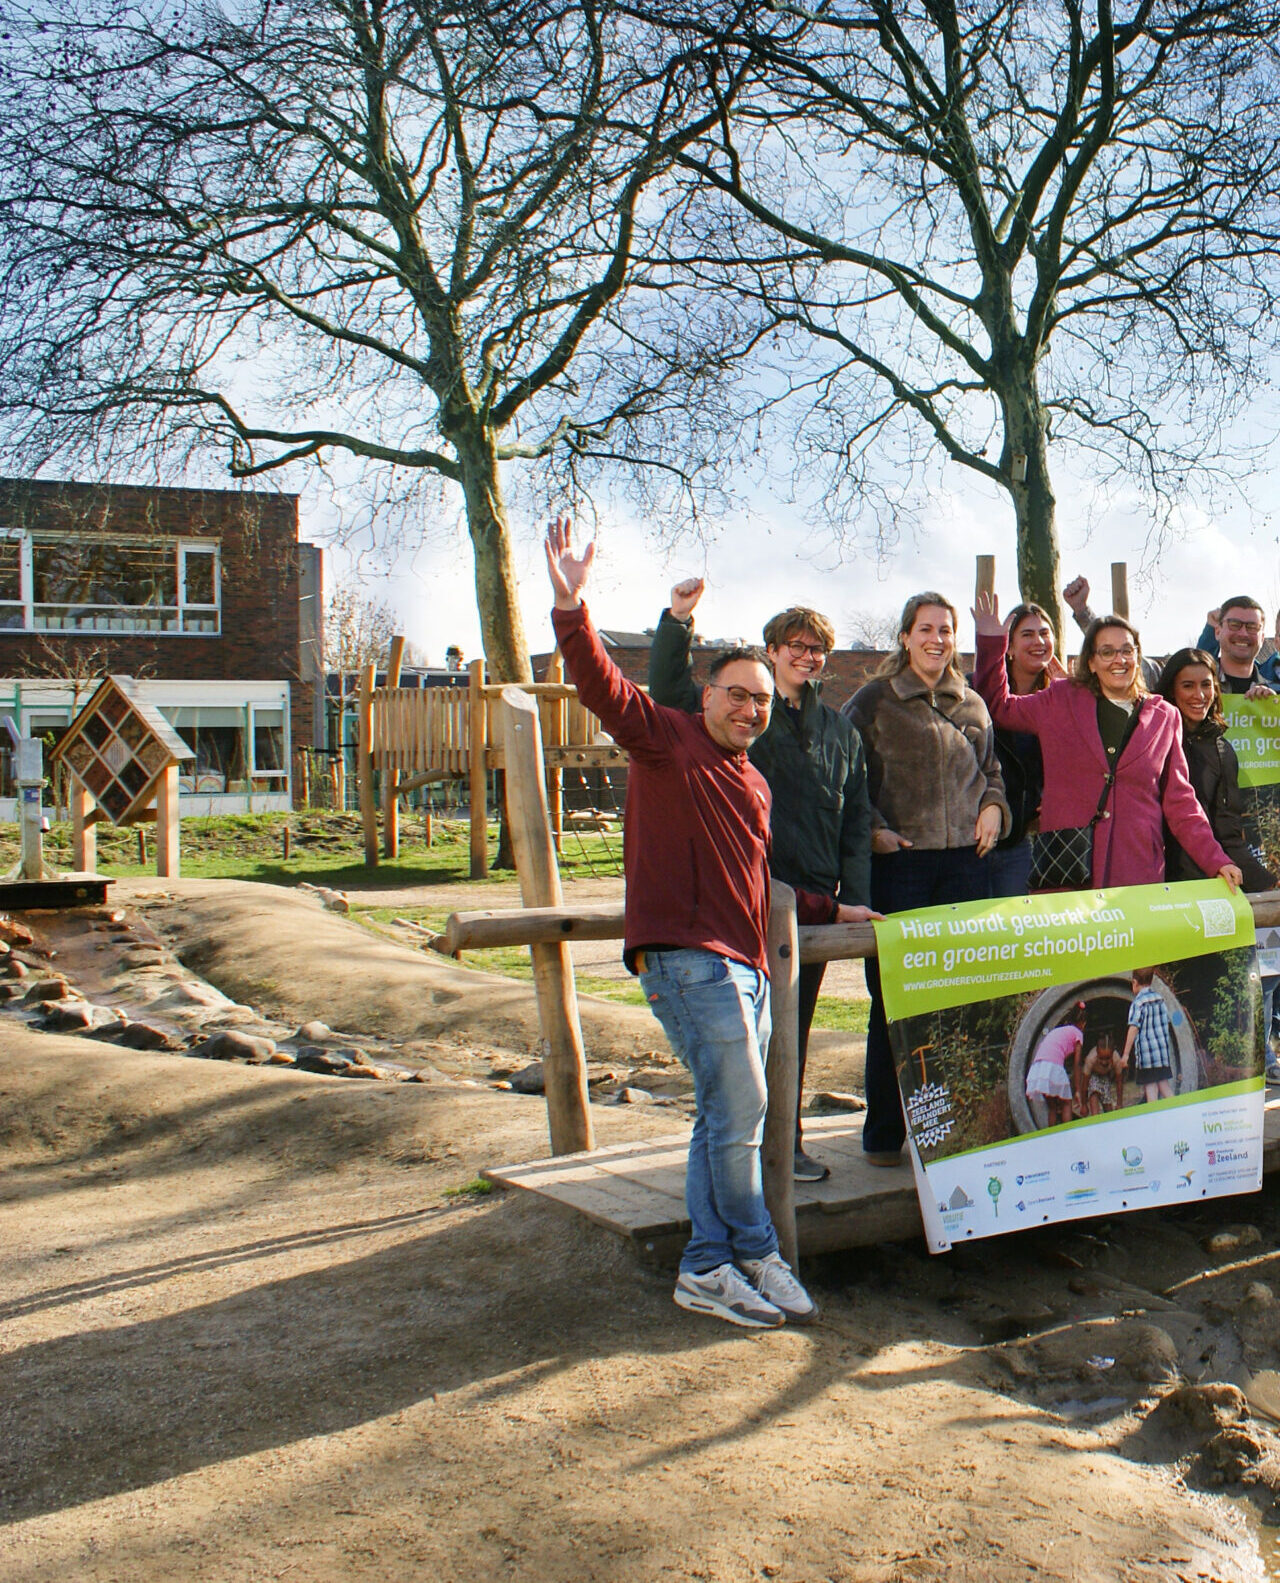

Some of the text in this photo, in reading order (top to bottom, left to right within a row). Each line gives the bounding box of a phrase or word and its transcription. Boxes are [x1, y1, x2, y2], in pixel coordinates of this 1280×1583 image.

[1228, 737, 1251, 752] en
[900, 907, 1126, 940] Hier wordt gewerkt aan
[903, 928, 1135, 971] een groener schoolplein!
[903, 967, 1053, 992] WWW.GROENEREVOLUTIEZEELAND.NL
[912, 1098, 945, 1118] ZEELAND
[923, 1117, 939, 1130] MEE
[1203, 1121, 1222, 1133] ivn
[1217, 1151, 1248, 1163] Zeeland
